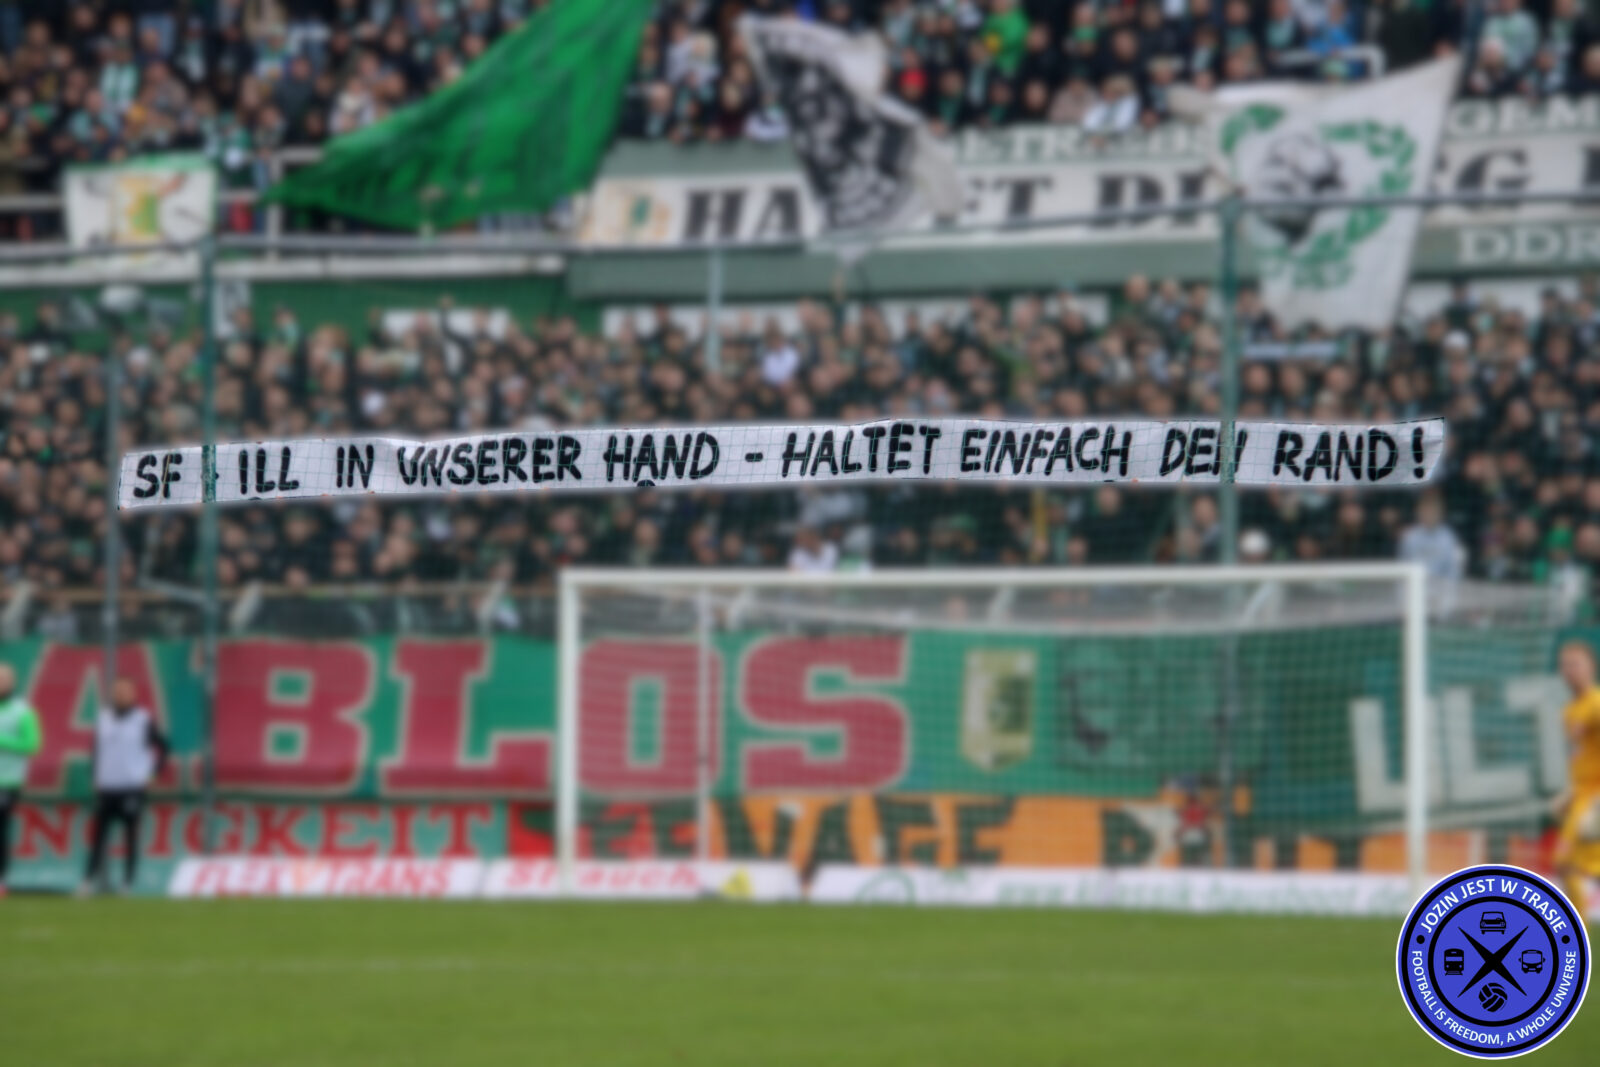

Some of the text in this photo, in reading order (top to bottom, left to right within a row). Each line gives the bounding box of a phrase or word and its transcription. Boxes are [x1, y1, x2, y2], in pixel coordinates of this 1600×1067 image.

[134, 454, 182, 498] SF
[239, 447, 299, 494] ILL
[337, 445, 374, 488] IN
[397, 434, 581, 486] UNSERER
[603, 433, 719, 481] HAND
[783, 423, 941, 477] HALTET
[961, 427, 1131, 476] EINFACH
